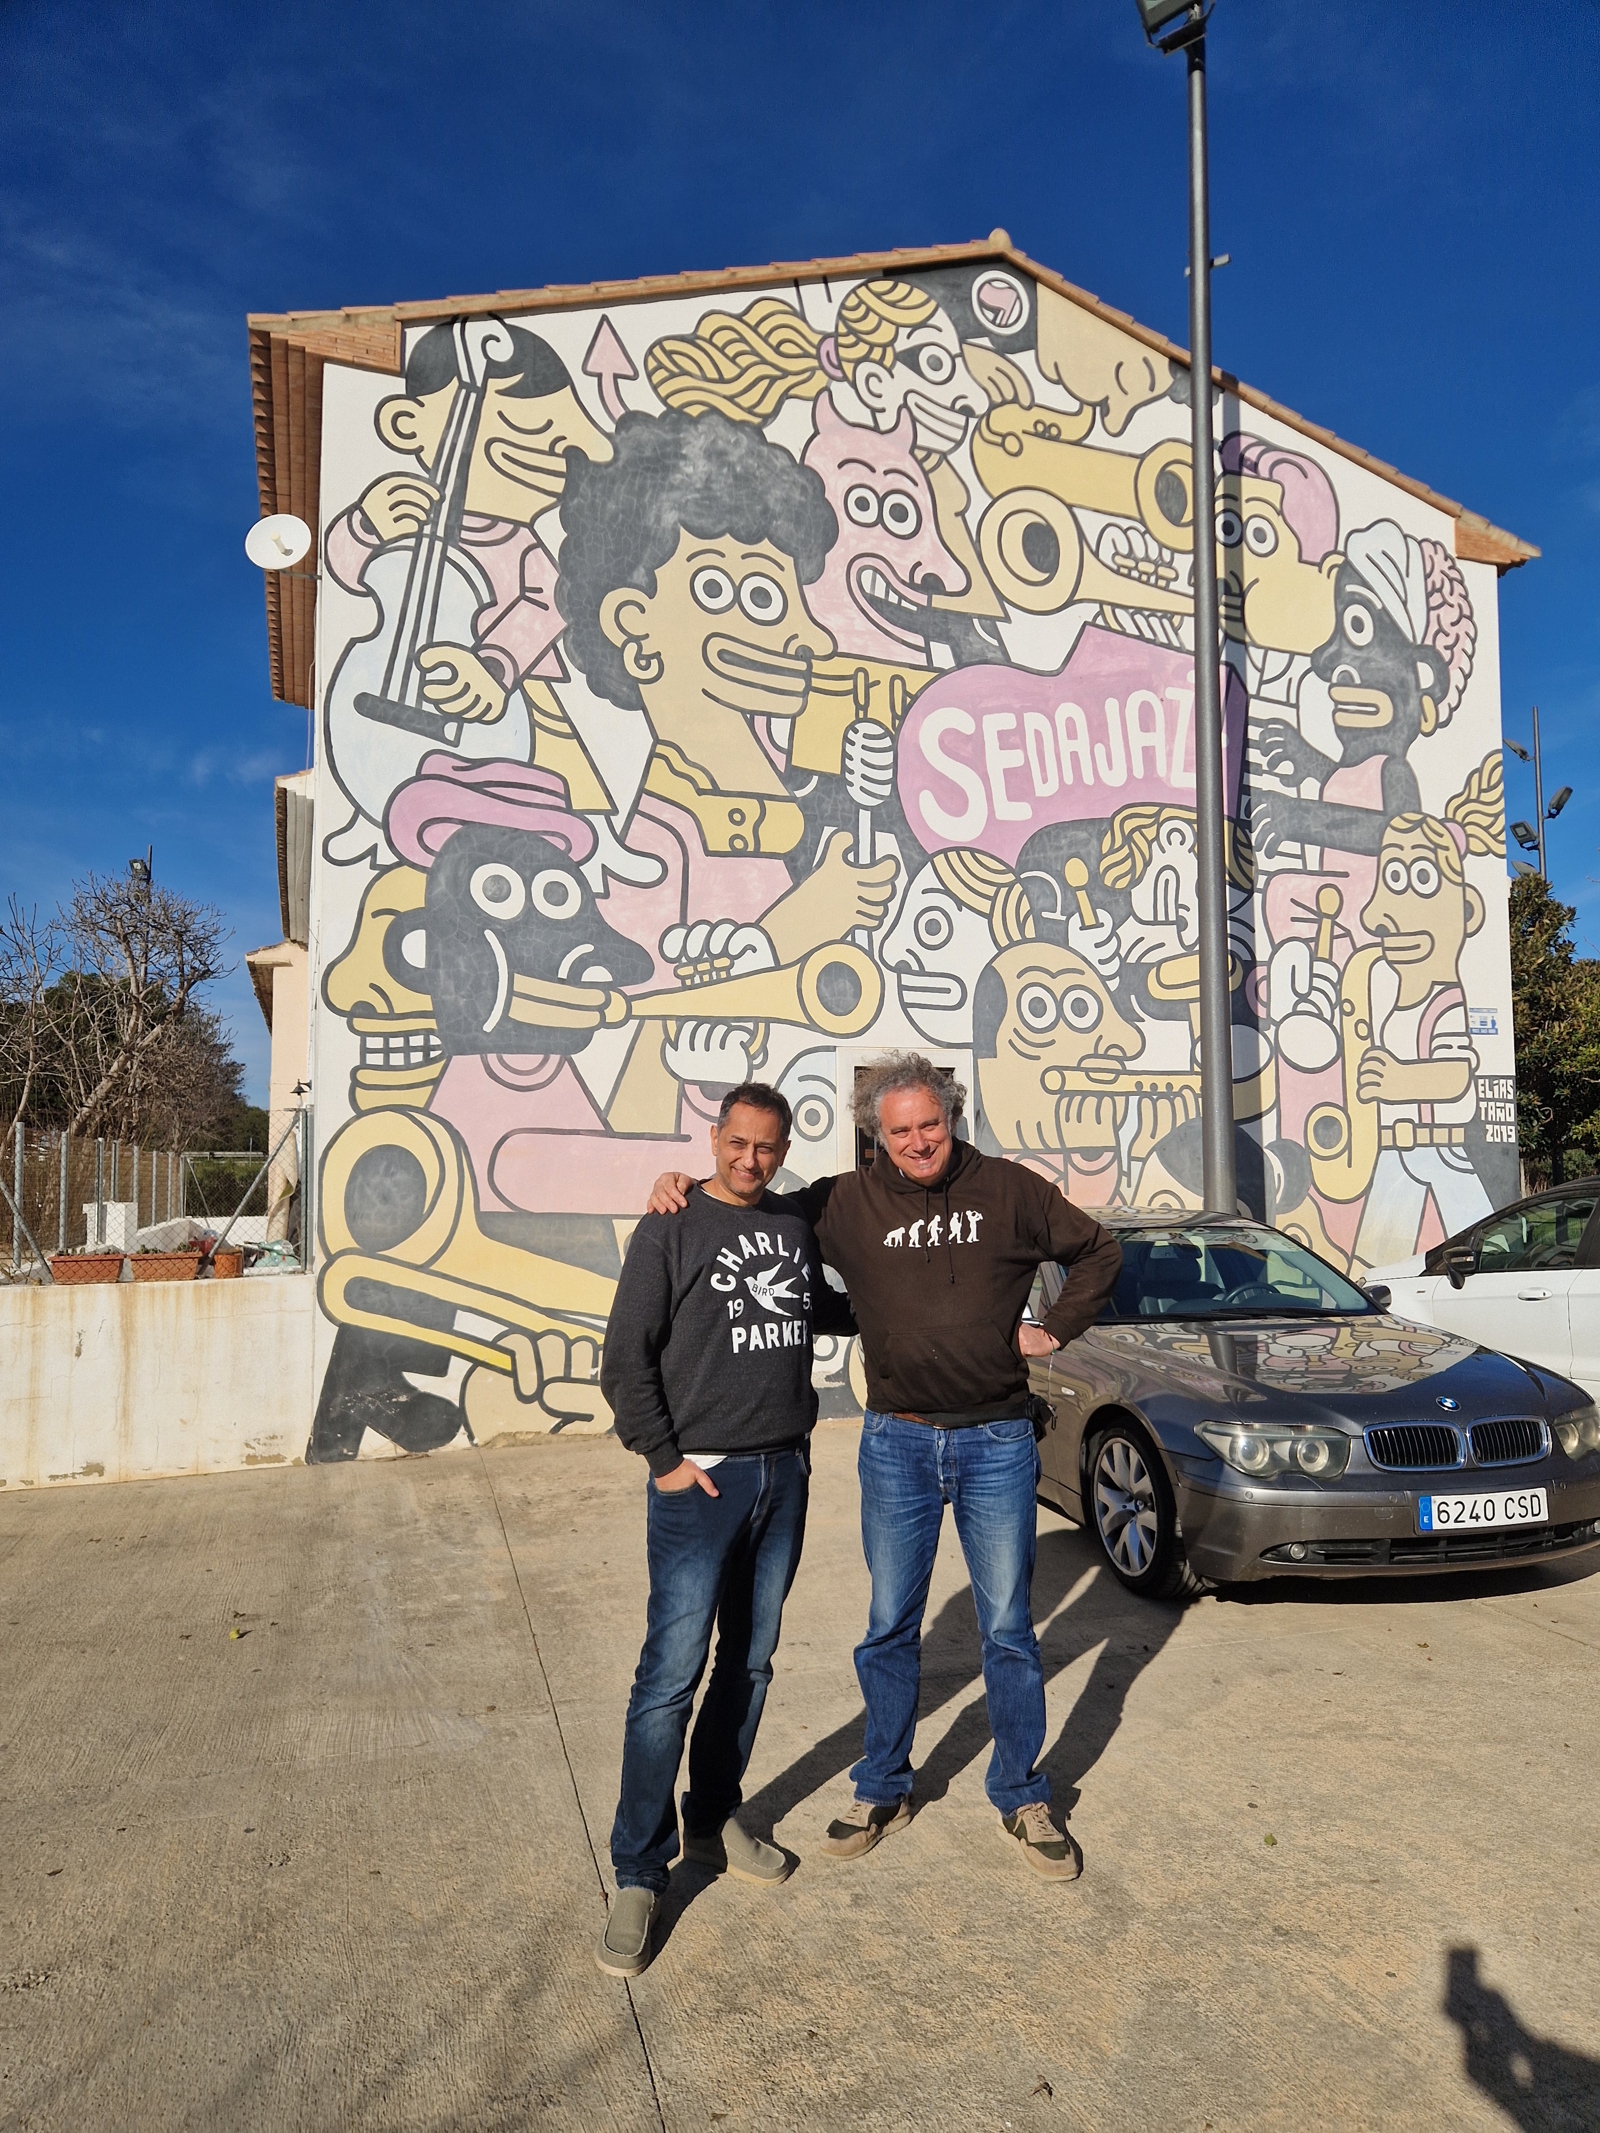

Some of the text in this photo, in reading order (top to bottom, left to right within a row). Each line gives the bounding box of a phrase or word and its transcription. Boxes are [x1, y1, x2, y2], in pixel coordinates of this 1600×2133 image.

[918, 670, 1229, 842] SEDAJAZ
[1486, 1124, 1516, 1143] 2019
[710, 1231, 812, 1292] CHARLIE
[751, 1283, 775, 1297] BIRD
[727, 1292, 813, 1320] 19 5
[731, 1320, 809, 1354] PARKER
[1437, 1499, 1495, 1523] 6240
[1504, 1494, 1541, 1519] CSD
